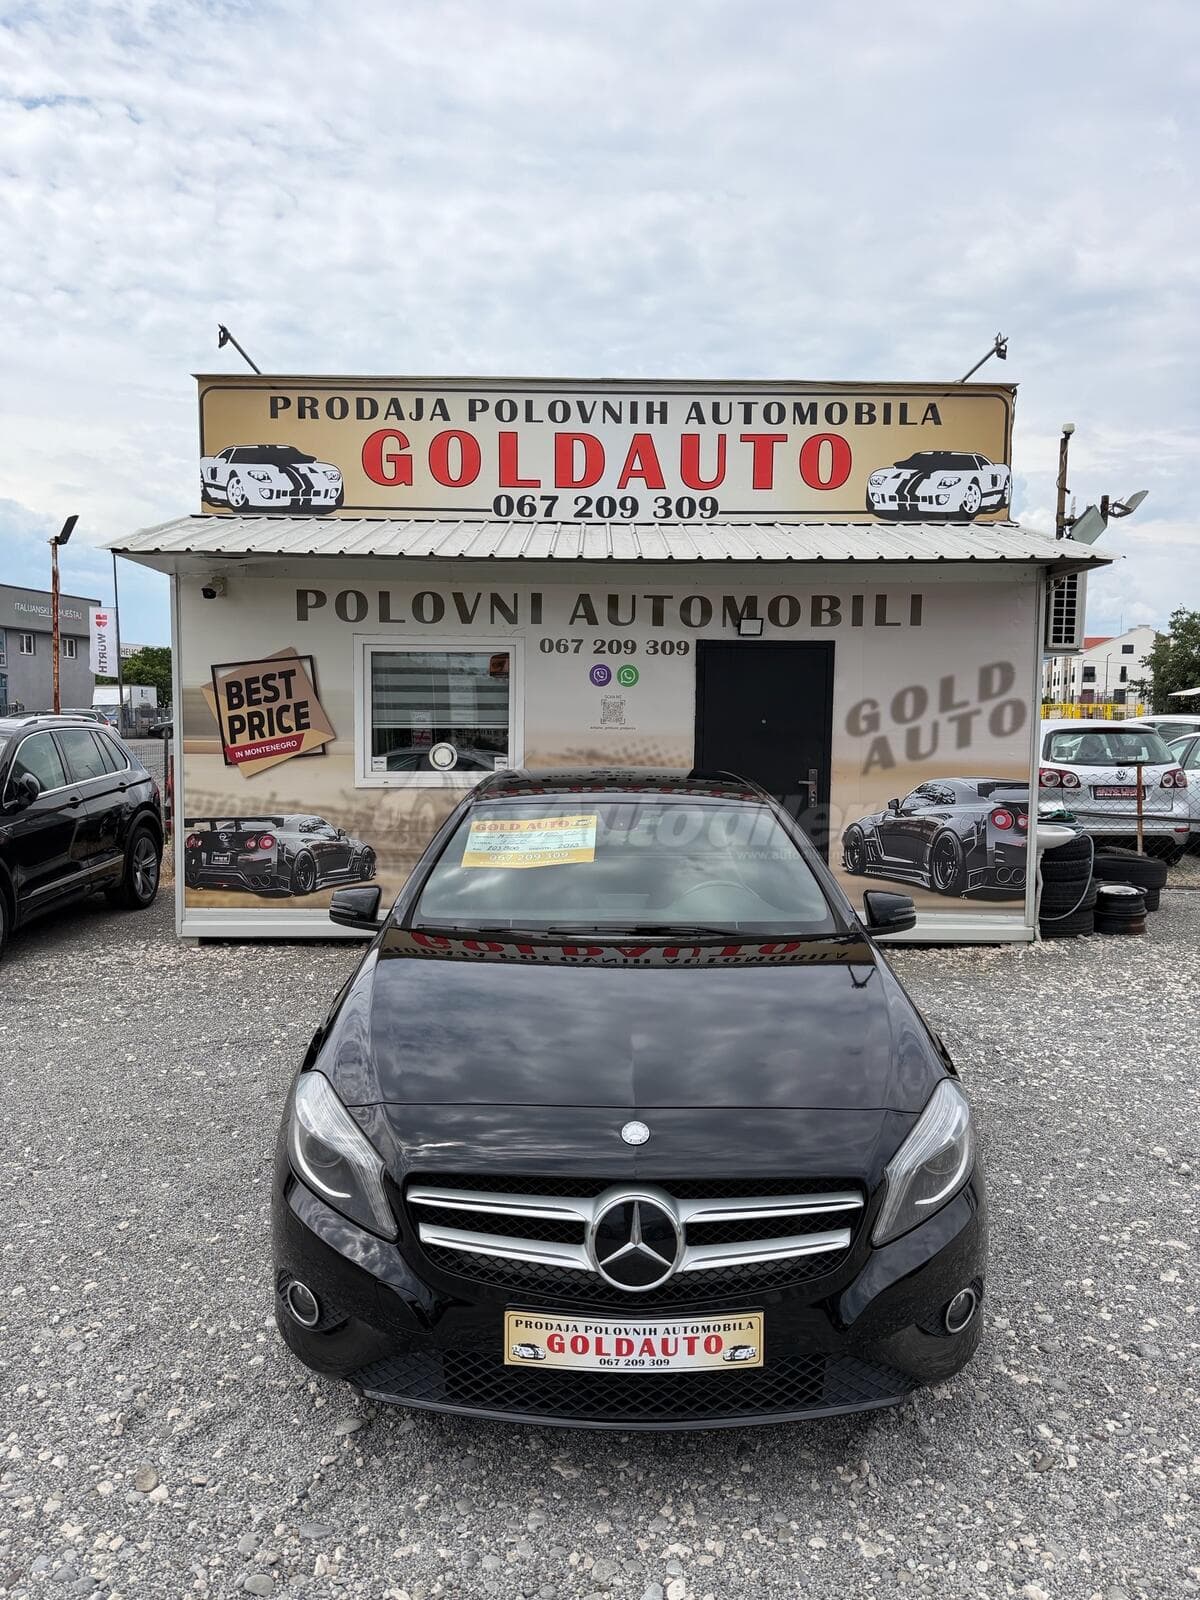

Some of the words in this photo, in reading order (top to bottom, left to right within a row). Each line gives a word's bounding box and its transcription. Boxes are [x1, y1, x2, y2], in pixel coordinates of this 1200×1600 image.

[270, 395, 451, 422] PRODAJA
[468, 398, 668, 425] POLOVNIH
[685, 401, 942, 426] AUTOMOBILA
[361, 428, 852, 490] GOLDAUTO
[492, 494, 560, 518] 067
[573, 494, 639, 519] 209
[652, 495, 719, 519] 309
[296, 588, 542, 625] POLOVNI
[568, 592, 923, 628] AUTOMOBILI
[539, 637, 584, 654] 067
[592, 638, 637, 655] 209
[645, 639, 690, 656] 309
[225, 669, 296, 711] BEST
[845, 661, 1015, 737] GOLD
[228, 700, 311, 744] PRICE
[245, 740, 298, 757] MONTENEGRO
[861, 698, 1027, 776] AUTO
[475, 823, 520, 832] GOLD
[526, 820, 570, 830] AUTO
[514, 1319, 579, 1334] PRODAJA
[585, 1324, 658, 1336] POLOVNIH
[663, 1321, 755, 1336] AUTOMOBILA
[546, 1333, 724, 1357] GOLDAUTO
[600, 1358, 620, 1366] 067
[624, 1358, 646, 1367] 209
[649, 1358, 670, 1367] 309
